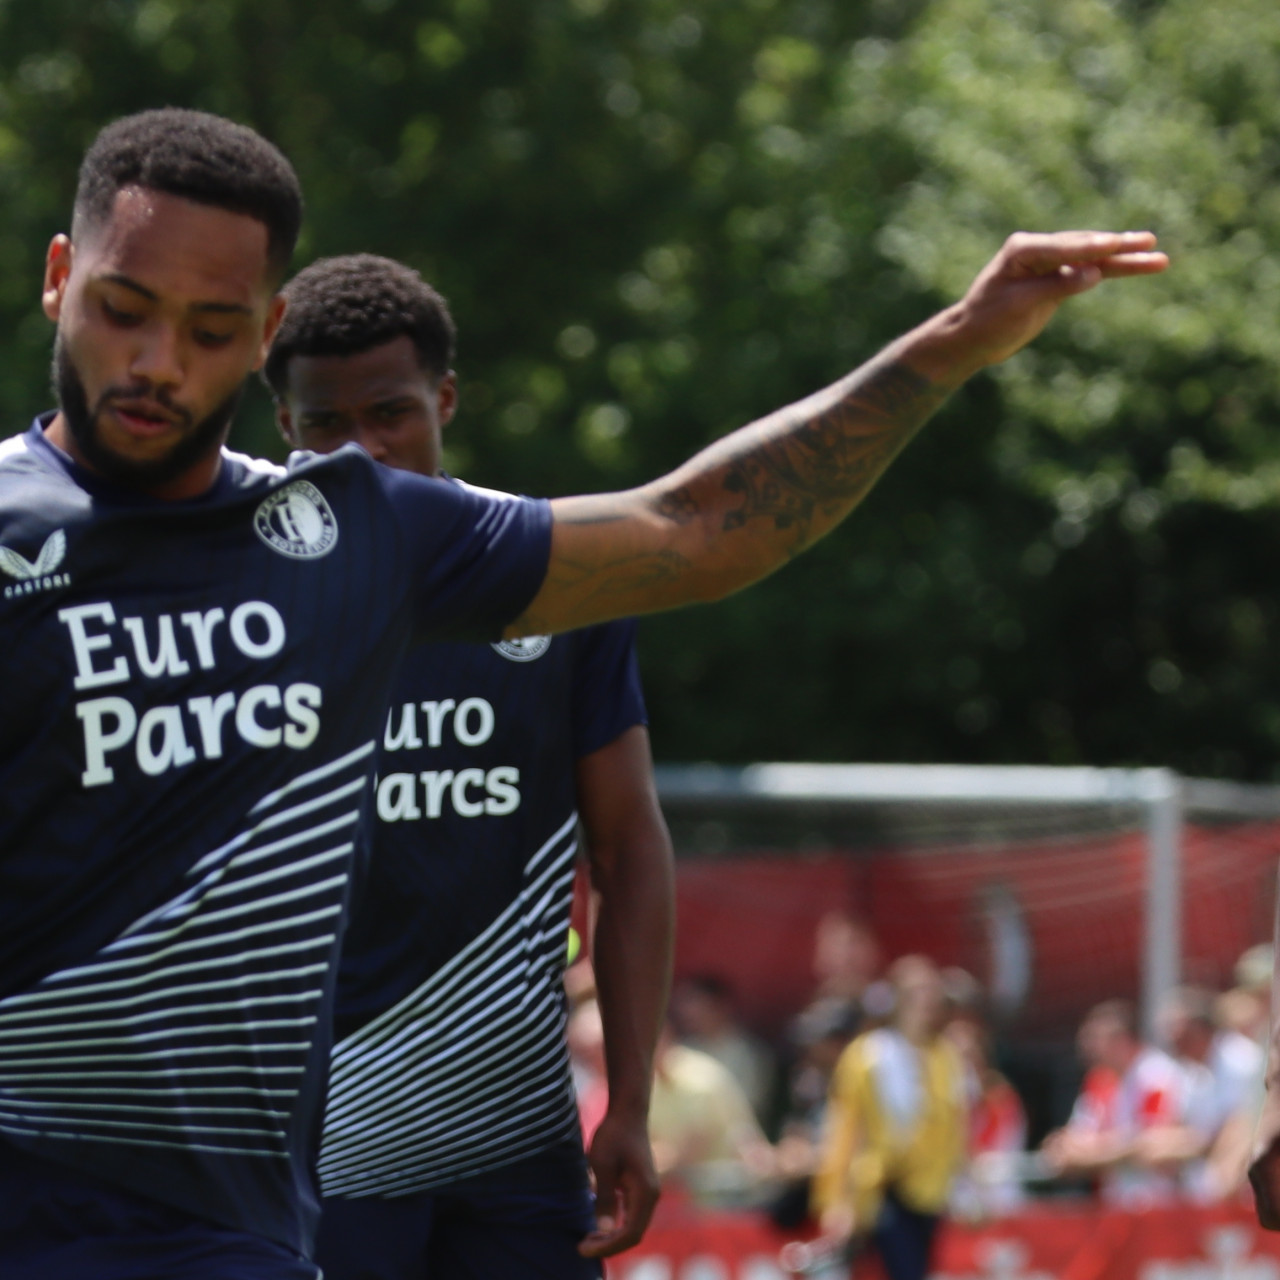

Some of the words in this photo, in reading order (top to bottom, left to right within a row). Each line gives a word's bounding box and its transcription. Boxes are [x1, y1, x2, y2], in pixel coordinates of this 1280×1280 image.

[58, 600, 286, 690] Euro
[76, 683, 322, 788] Parcs
[383, 697, 495, 752] uro
[375, 766, 521, 823] arcs
